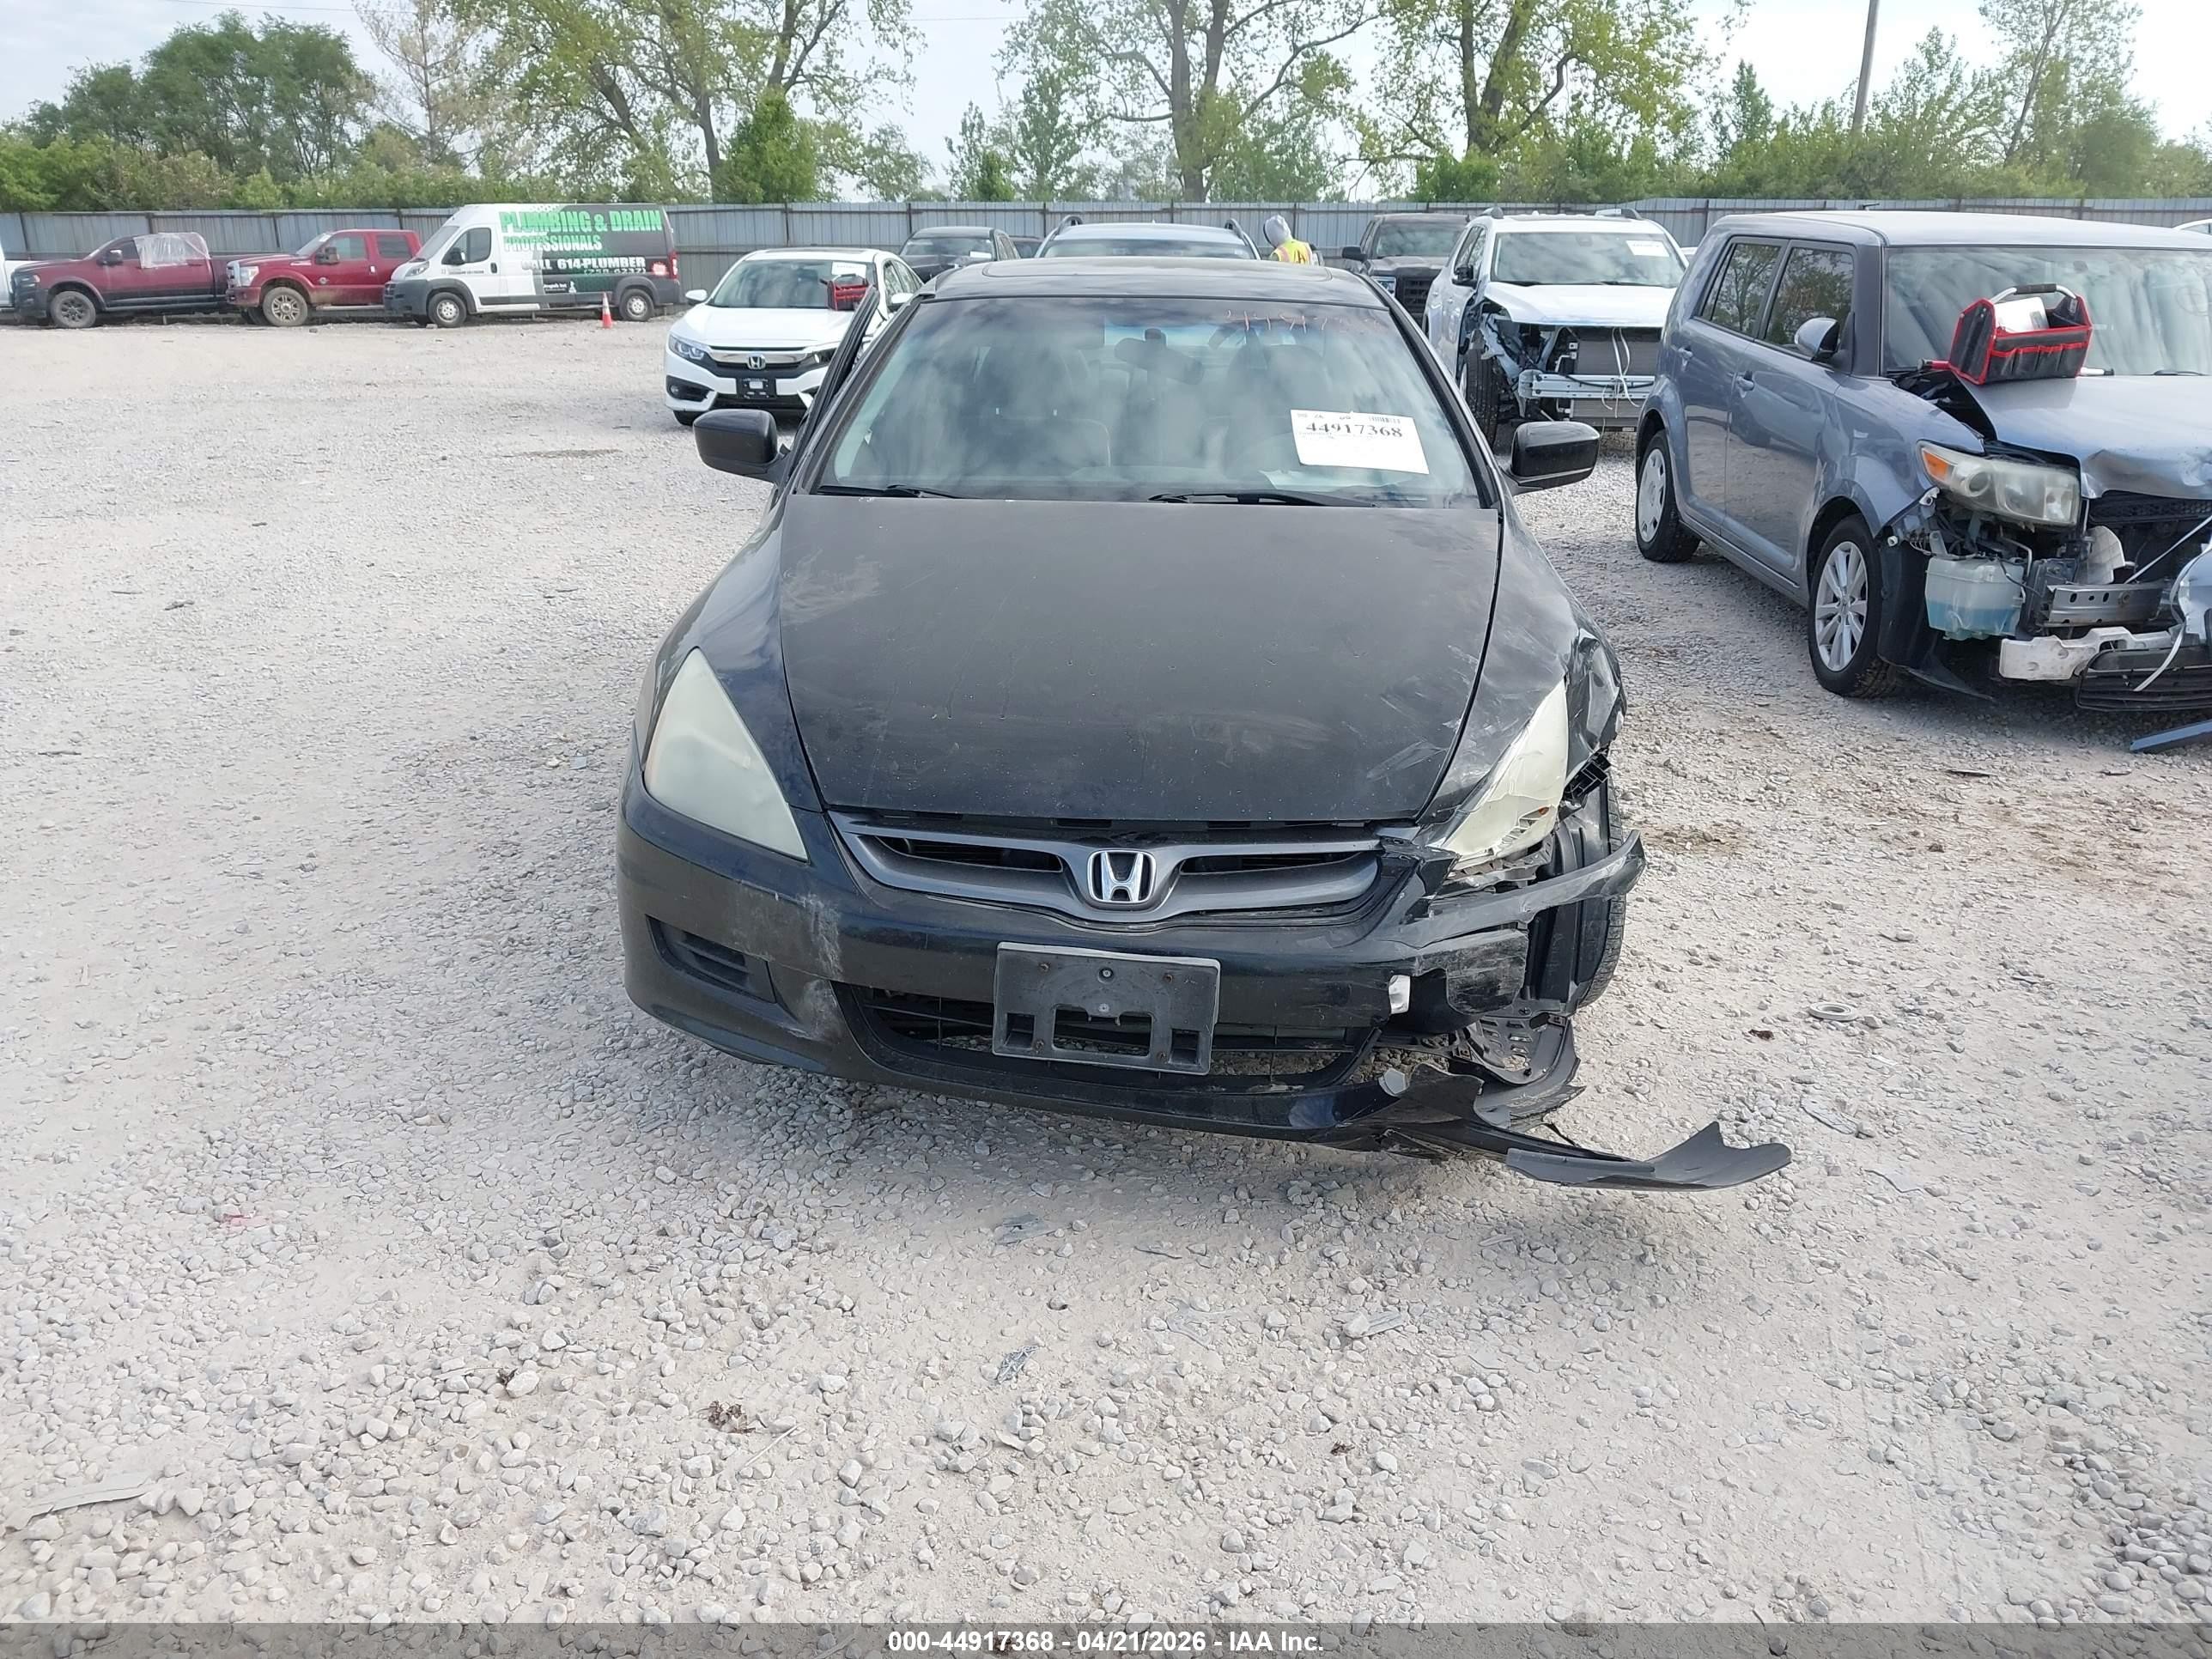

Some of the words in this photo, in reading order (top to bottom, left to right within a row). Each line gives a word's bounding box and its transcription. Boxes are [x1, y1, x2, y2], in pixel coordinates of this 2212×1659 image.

[500, 211, 591, 233] PLUMBING
[594, 215, 608, 232] &
[609, 210, 662, 231] DRAIN
[504, 234, 603, 252] PROFESSIONALS
[521, 259, 553, 270] CALL
[1305, 422, 1403, 438] 44917368
